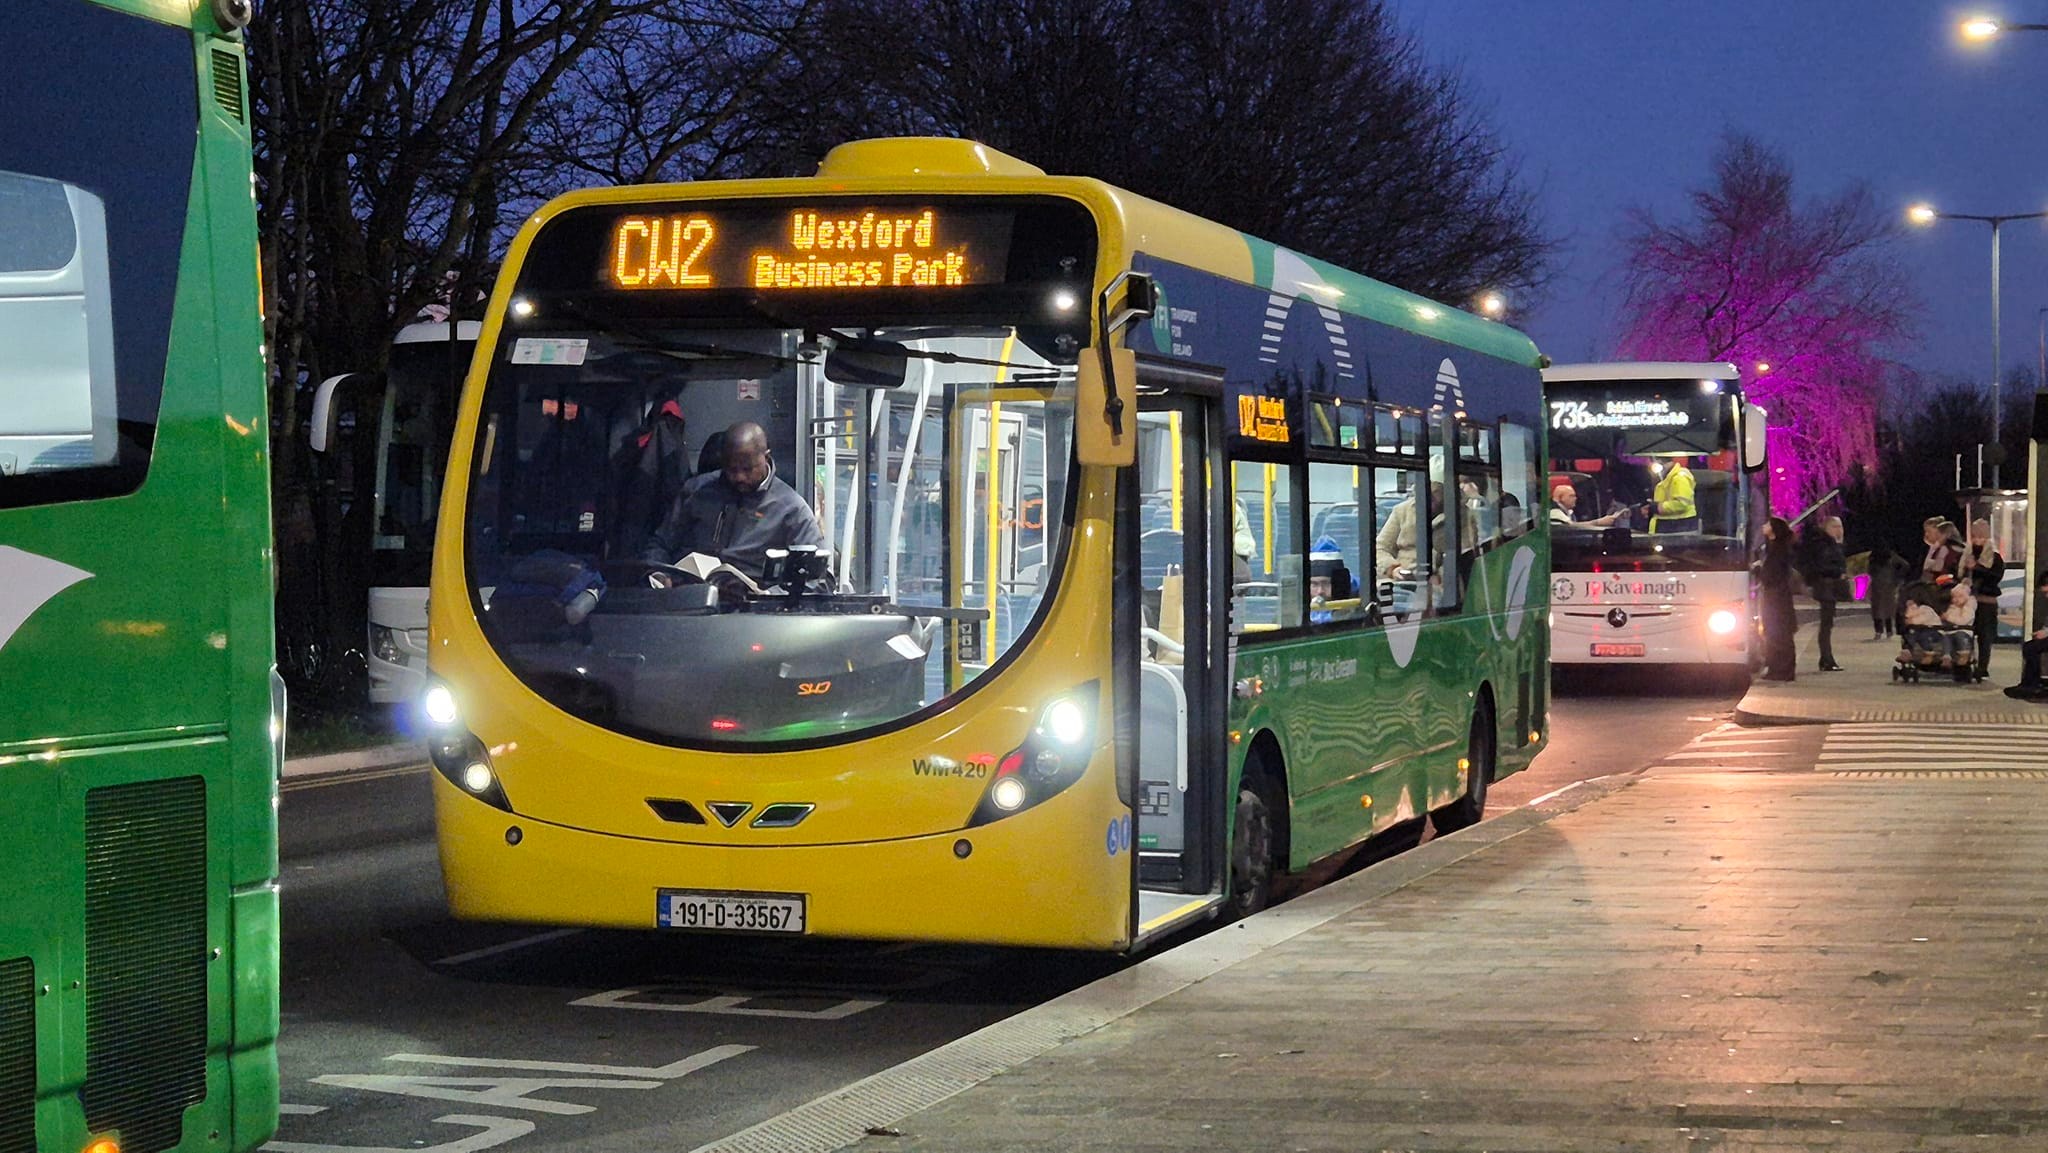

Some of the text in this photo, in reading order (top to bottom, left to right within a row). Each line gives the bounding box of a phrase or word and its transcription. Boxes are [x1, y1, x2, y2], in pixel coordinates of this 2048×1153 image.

[793, 211, 933, 250] Wexford
[616, 218, 713, 286] CW2
[754, 251, 964, 288] Business Park
[1550, 401, 1589, 429] 736
[1602, 580, 1687, 598] Kavanagh
[912, 759, 987, 778] WM420
[678, 902, 793, 929] 191-D-33567
